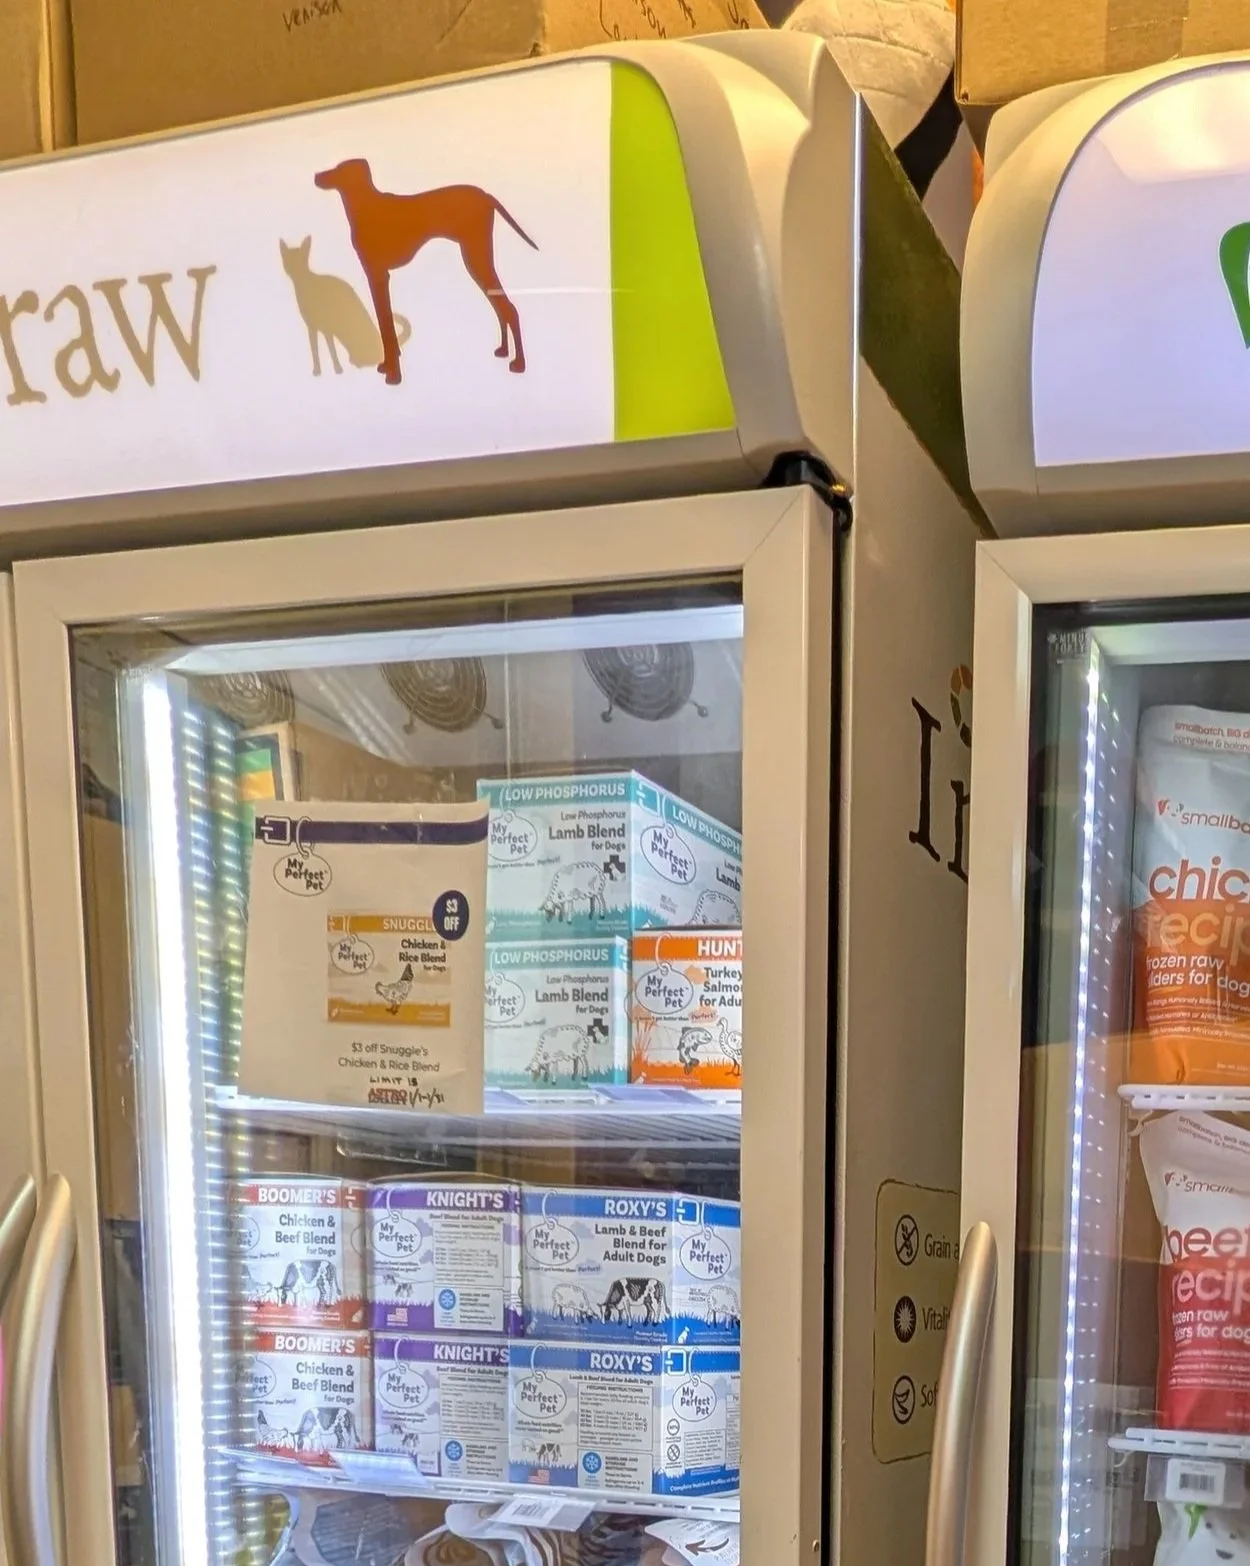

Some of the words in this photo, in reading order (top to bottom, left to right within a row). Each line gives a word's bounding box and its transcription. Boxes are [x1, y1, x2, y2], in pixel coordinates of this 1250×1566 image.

[0, 264, 217, 406] raw
[505, 787, 534, 801] LOW
[536, 783, 626, 799] PHOSPHORUS
[577, 807, 626, 820] Phosphorus
[492, 822, 507, 836] My
[549, 825, 584, 841] Lamb
[588, 822, 626, 839] Blend
[490, 833, 529, 844] Perfect
[653, 829, 669, 849] My
[510, 844, 528, 855] Pet
[591, 841, 604, 850] for
[605, 842, 626, 853] Dogs
[651, 841, 689, 871] Perfect
[286, 858, 304, 870] My
[284, 868, 325, 881] Perfect
[671, 864, 688, 882] Pet
[715, 866, 741, 892] Lamb
[305, 878, 324, 891] Pet
[443, 915, 460, 932] OFF
[401, 938, 438, 950] Chicken
[440, 940, 446, 949] &
[399, 951, 419, 962] Rice
[421, 952, 446, 963] Blend
[494, 951, 522, 965] LOW
[523, 948, 609, 963] PHOSPHORUS
[1188, 955, 1225, 971] raw
[647, 974, 663, 989] My
[703, 967, 742, 986] Turkey
[1187, 971, 1213, 985] for
[535, 989, 569, 1003] Lamb
[572, 988, 609, 1002] Blend
[644, 985, 685, 998] Perfect
[664, 995, 683, 1008] Pet
[698, 994, 717, 1007] for
[499, 1005, 516, 1017] Pet
[351, 1042, 364, 1053] $3
[365, 1044, 378, 1053] off
[338, 1056, 377, 1069] Chicken
[380, 1059, 387, 1070] &
[389, 1060, 410, 1071] Rice
[412, 1060, 440, 1073] Blend
[258, 1187, 336, 1205] BOOMER'S
[426, 1191, 504, 1209] KNIGHT'S
[604, 1199, 667, 1217] ROXY'S
[279, 1213, 325, 1227] Chicken
[327, 1214, 336, 1228] &
[380, 1222, 394, 1235] My
[535, 1228, 550, 1241] My
[594, 1224, 628, 1236] Lamb
[629, 1225, 638, 1236] &
[640, 1226, 666, 1238] Beef
[275, 1231, 302, 1244] Beef
[302, 1231, 336, 1245] Blend
[378, 1232, 415, 1243] Perfect
[613, 1237, 646, 1249] Blend
[648, 1238, 667, 1250] for
[397, 1242, 414, 1253] Pet
[533, 1239, 571, 1250] Perfect
[691, 1239, 707, 1252] My
[924, 1233, 951, 1259] Grain
[552, 1250, 569, 1261] Pet
[602, 1250, 635, 1263] Adult
[637, 1252, 666, 1266] Dogs
[689, 1251, 725, 1264] Perfect
[708, 1263, 724, 1275] Pet
[1196, 1309, 1231, 1323] raw
[1196, 1323, 1219, 1338] for
[274, 1335, 356, 1354] BOOMER'S
[295, 1361, 343, 1376] Chicken
[345, 1364, 355, 1377] &
[590, 1352, 653, 1373] ROXY'S
[291, 1378, 318, 1392] Beef
[320, 1379, 355, 1393] Blend
[387, 1373, 402, 1386] My
[386, 1383, 420, 1394] Perfect
[522, 1381, 538, 1394] My
[682, 1386, 695, 1400] My
[403, 1393, 420, 1404] Pet
[520, 1391, 559, 1404] Perfect
[680, 1395, 711, 1406] Perfect
[539, 1403, 557, 1414] Pet
[695, 1405, 710, 1416] Pet
